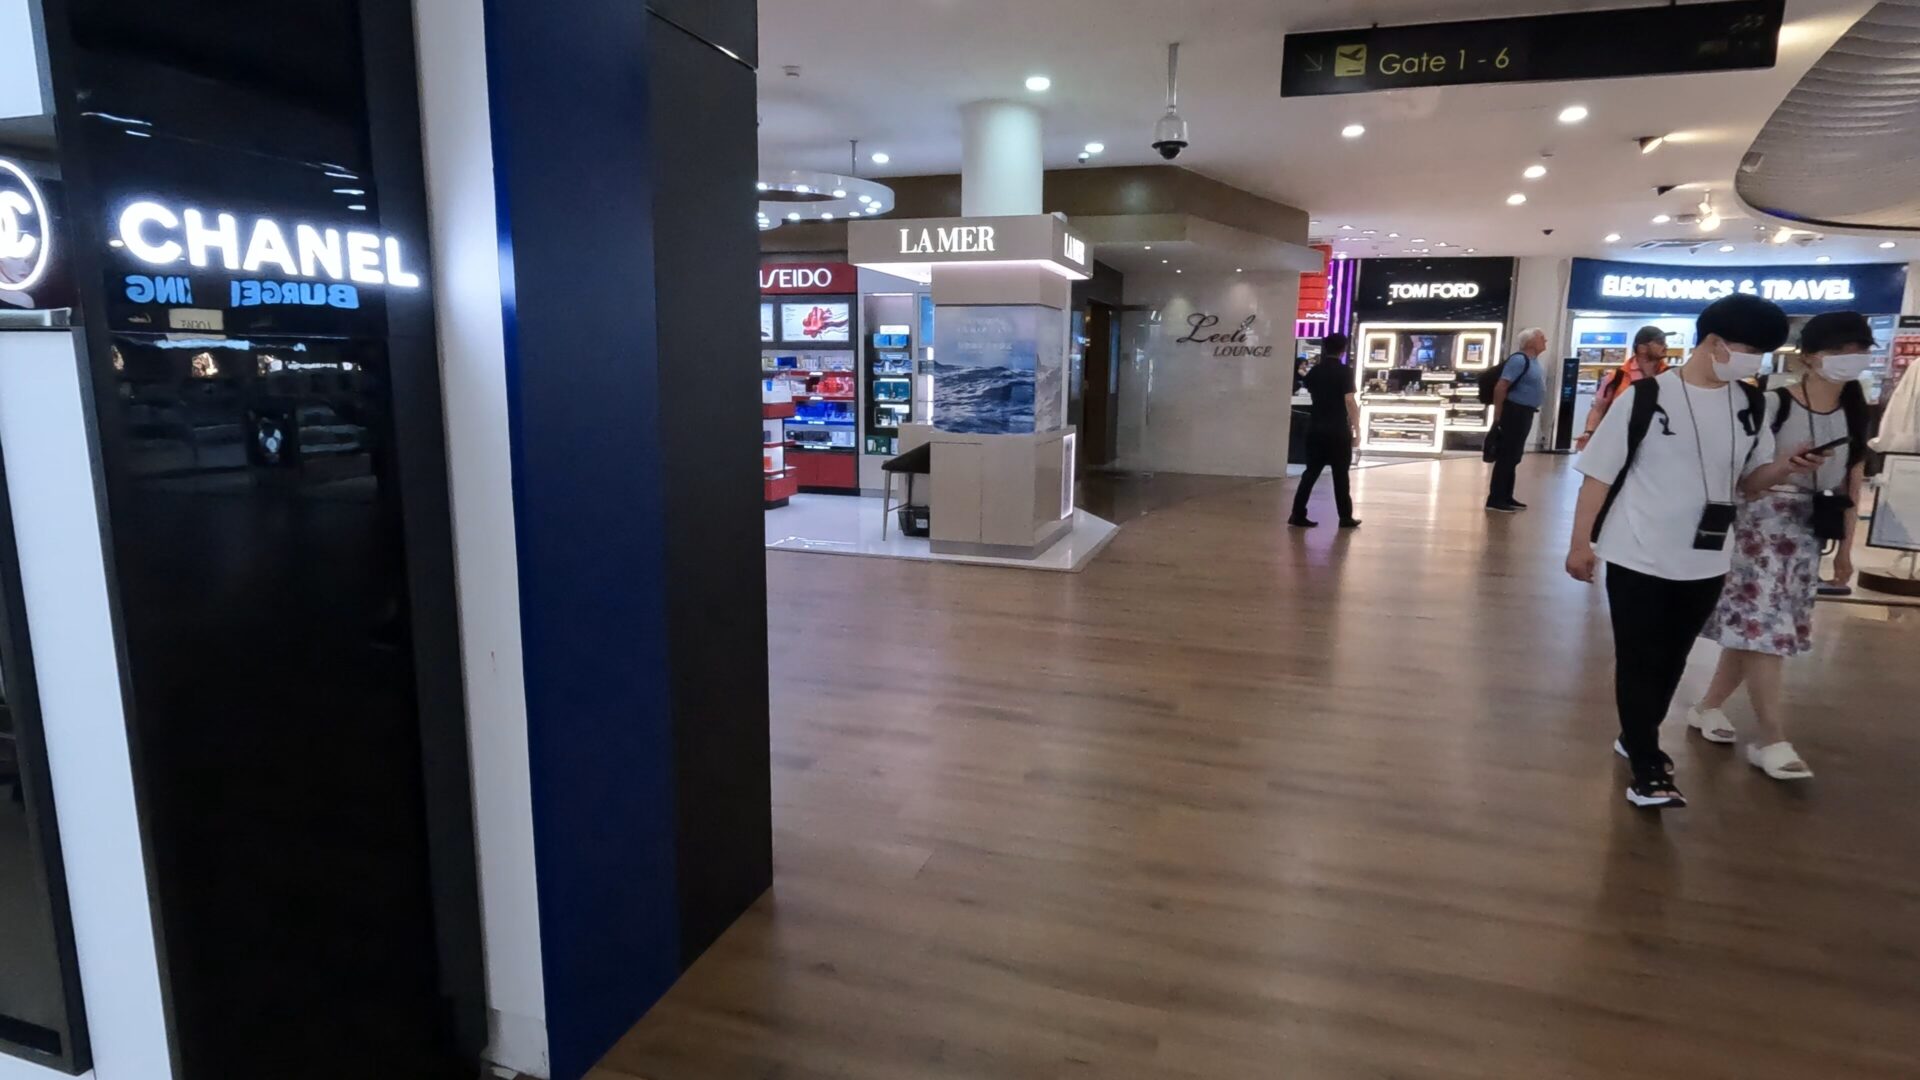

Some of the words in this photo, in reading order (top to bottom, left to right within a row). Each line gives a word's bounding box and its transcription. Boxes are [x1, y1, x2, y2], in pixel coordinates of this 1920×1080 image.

[1379, 52, 1446, 75] Gate
[1459, 49, 1465, 71] 1
[1495, 47, 1510, 69] 6
[118, 201, 420, 288] CHANEL
[937, 226, 996, 253] MER
[759, 268, 832, 289] ISEIDO
[1389, 283, 1428, 298] TOM
[1429, 283, 1479, 298] FORD
[1602, 275, 1735, 299] ELECTRONICS
[1760, 279, 1855, 300] TRAVEL
[1213, 346, 1273, 357] LOUNGE
